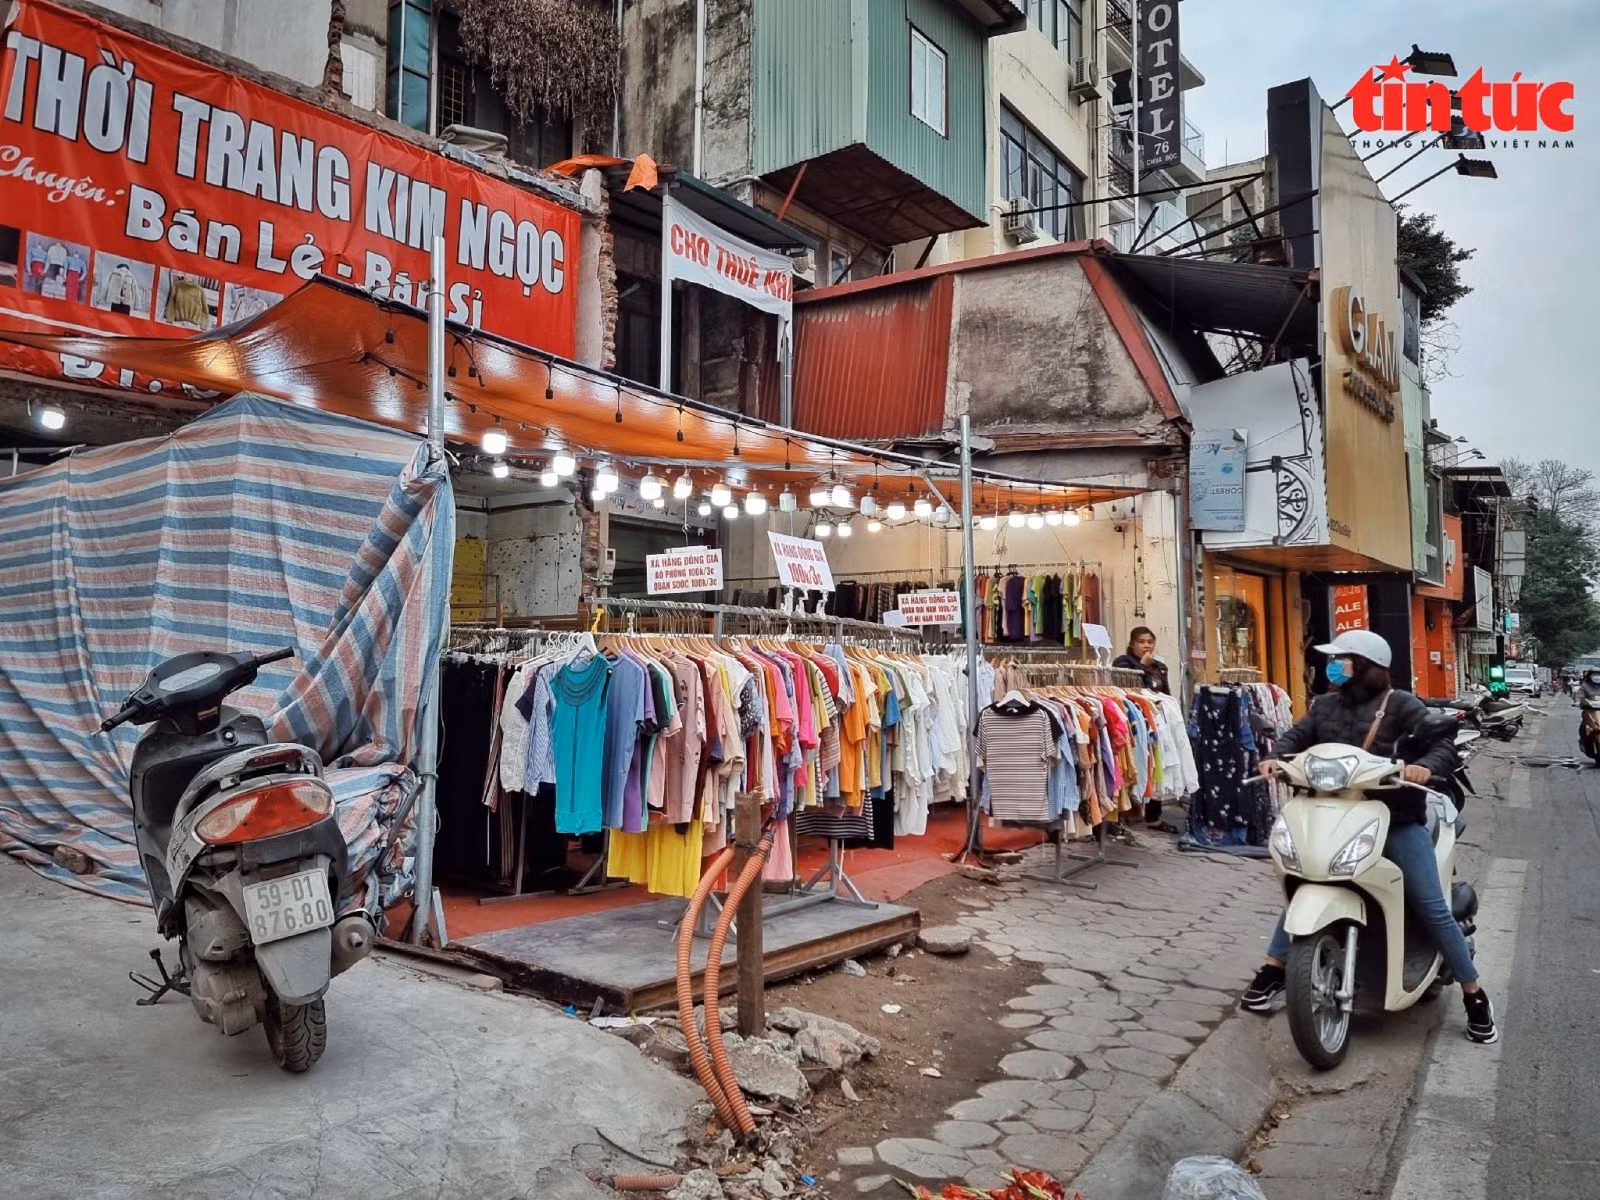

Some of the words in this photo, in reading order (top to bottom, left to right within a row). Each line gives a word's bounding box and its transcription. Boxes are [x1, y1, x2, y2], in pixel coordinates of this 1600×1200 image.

[1148, 0, 1175, 136] OTEL
[4, 31, 154, 165] THỜI
[172, 91, 351, 222] TRANG
[365, 160, 447, 253] KIM
[457, 197, 565, 297] NGỌC
[1153, 140, 1170, 156] 76
[124, 183, 242, 264] Bán
[256, 219, 326, 280] Lẻ
[670, 223, 710, 267] CHO
[715, 244, 760, 290] THUÊ
[253, 898, 329, 938] 876.80
[256, 875, 315, 911] 59-D1
